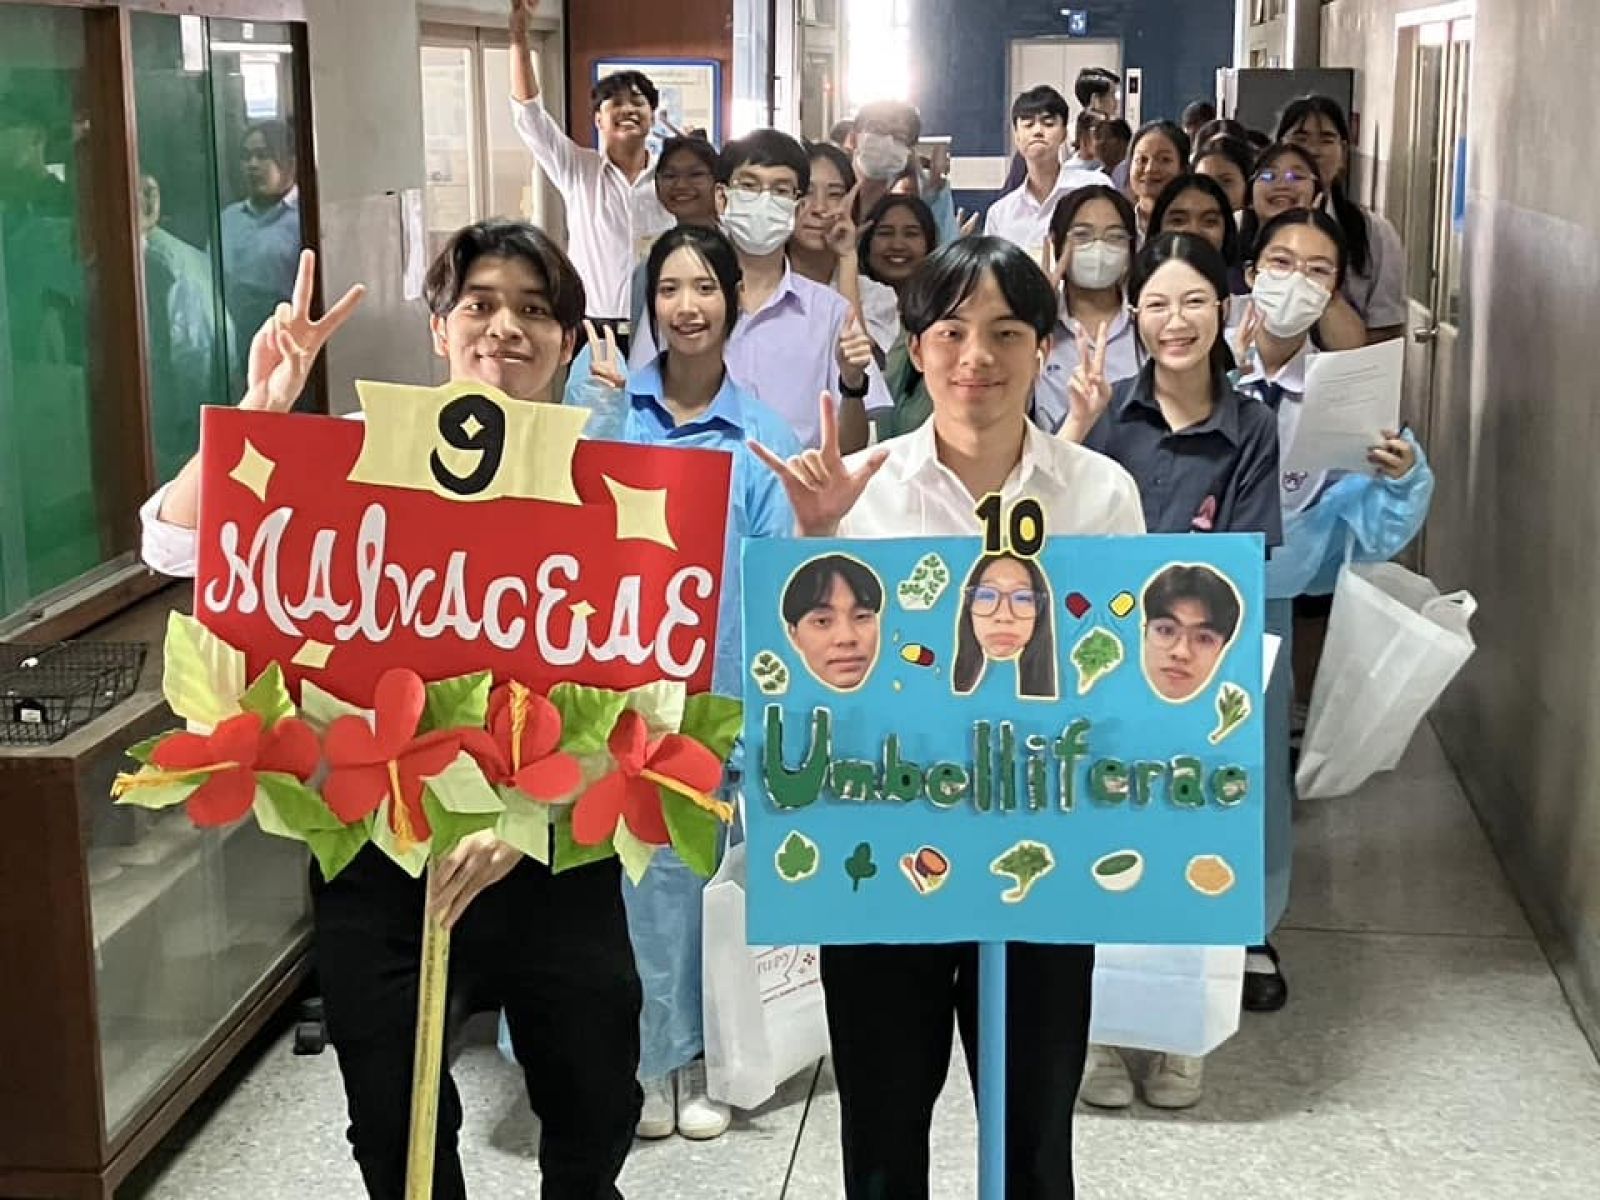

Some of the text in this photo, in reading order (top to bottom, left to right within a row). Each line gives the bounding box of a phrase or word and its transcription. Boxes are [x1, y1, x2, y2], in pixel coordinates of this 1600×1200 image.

[1072, 14, 1085, 31] 5
[430, 394, 505, 495] 9
[975, 496, 1043, 555] 10
[763, 705, 1248, 813] Umbelliferae
